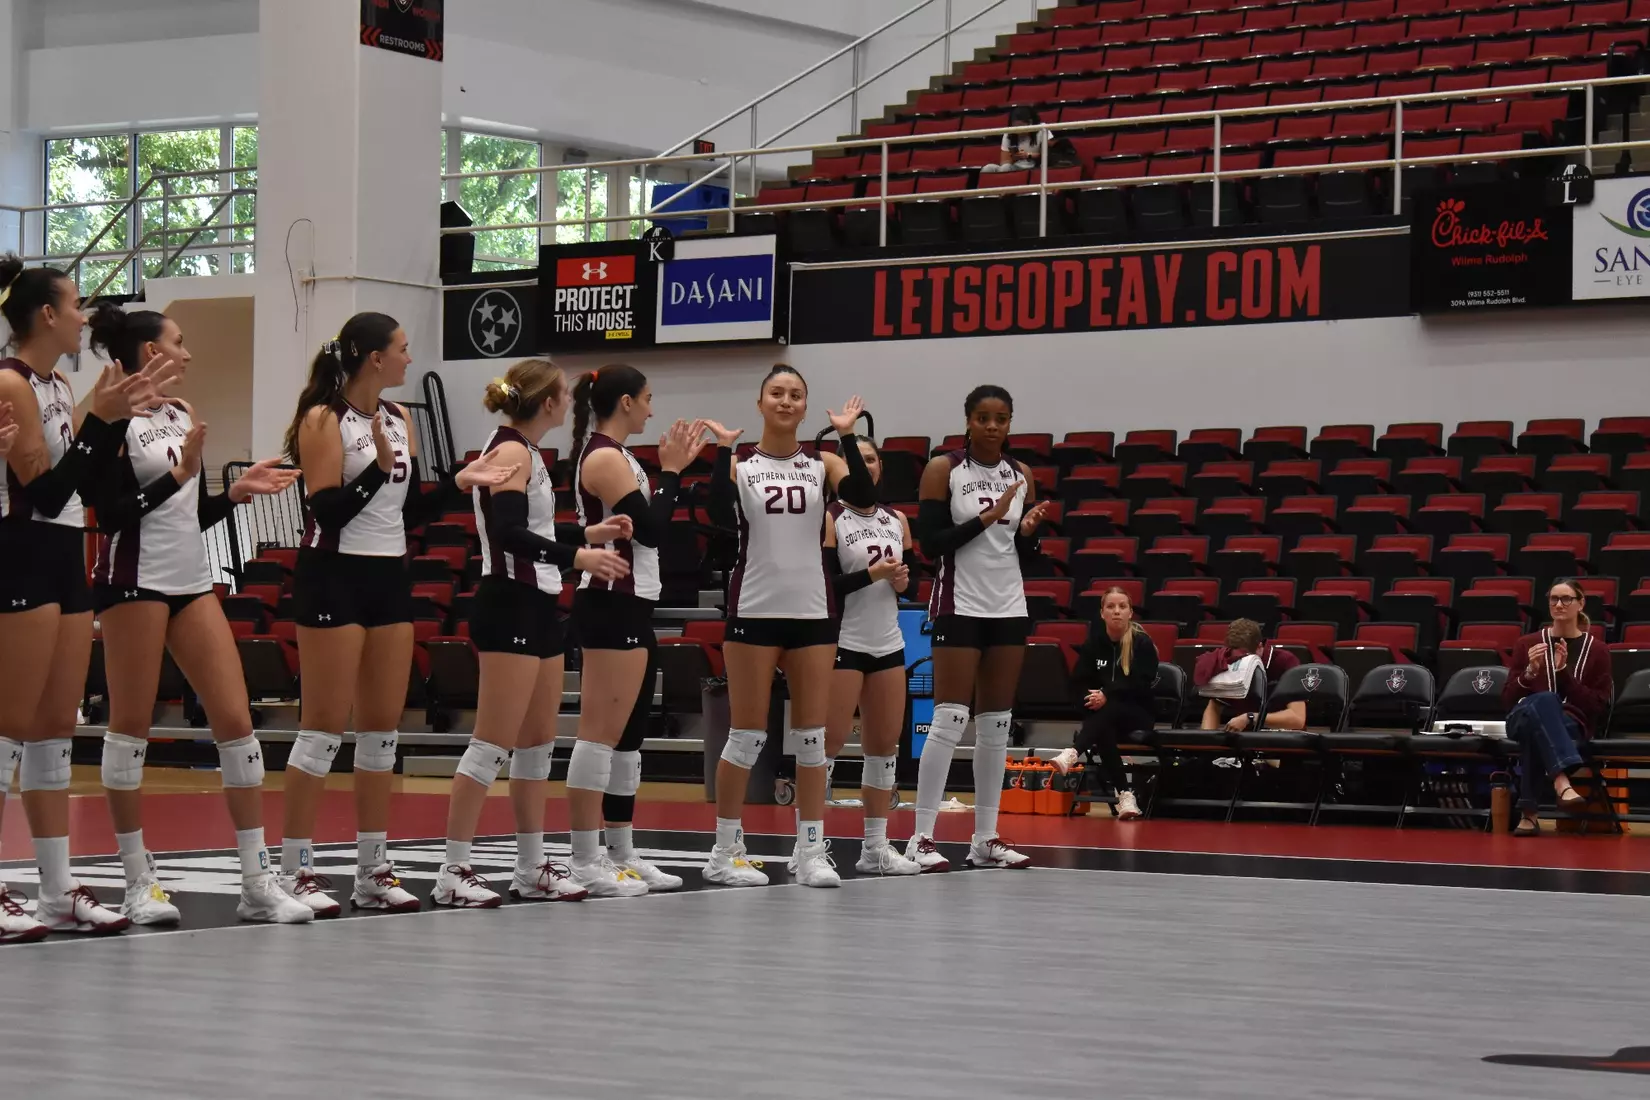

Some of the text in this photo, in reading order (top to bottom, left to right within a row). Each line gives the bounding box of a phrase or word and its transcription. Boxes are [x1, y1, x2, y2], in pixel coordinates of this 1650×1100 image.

[379, 34, 426, 52] RESTROOMS
[1563, 181, 1577, 204] L
[1431, 200, 1548, 247] Chick-fil-A
[649, 241, 664, 261] K
[1451, 255, 1482, 267] Wilma
[1485, 253, 1528, 266] Rudolph
[671, 272, 762, 309] DASANI
[873, 245, 1321, 336] LETSGOPEAY.COM
[1617, 274, 1643, 286] EYE
[555, 285, 634, 312] PROTECT
[554, 311, 636, 332] THIS HOUSE.
[748, 471, 786, 487] SOUTHERN
[764, 485, 807, 515] 20
[978, 497, 1011, 525] 2
